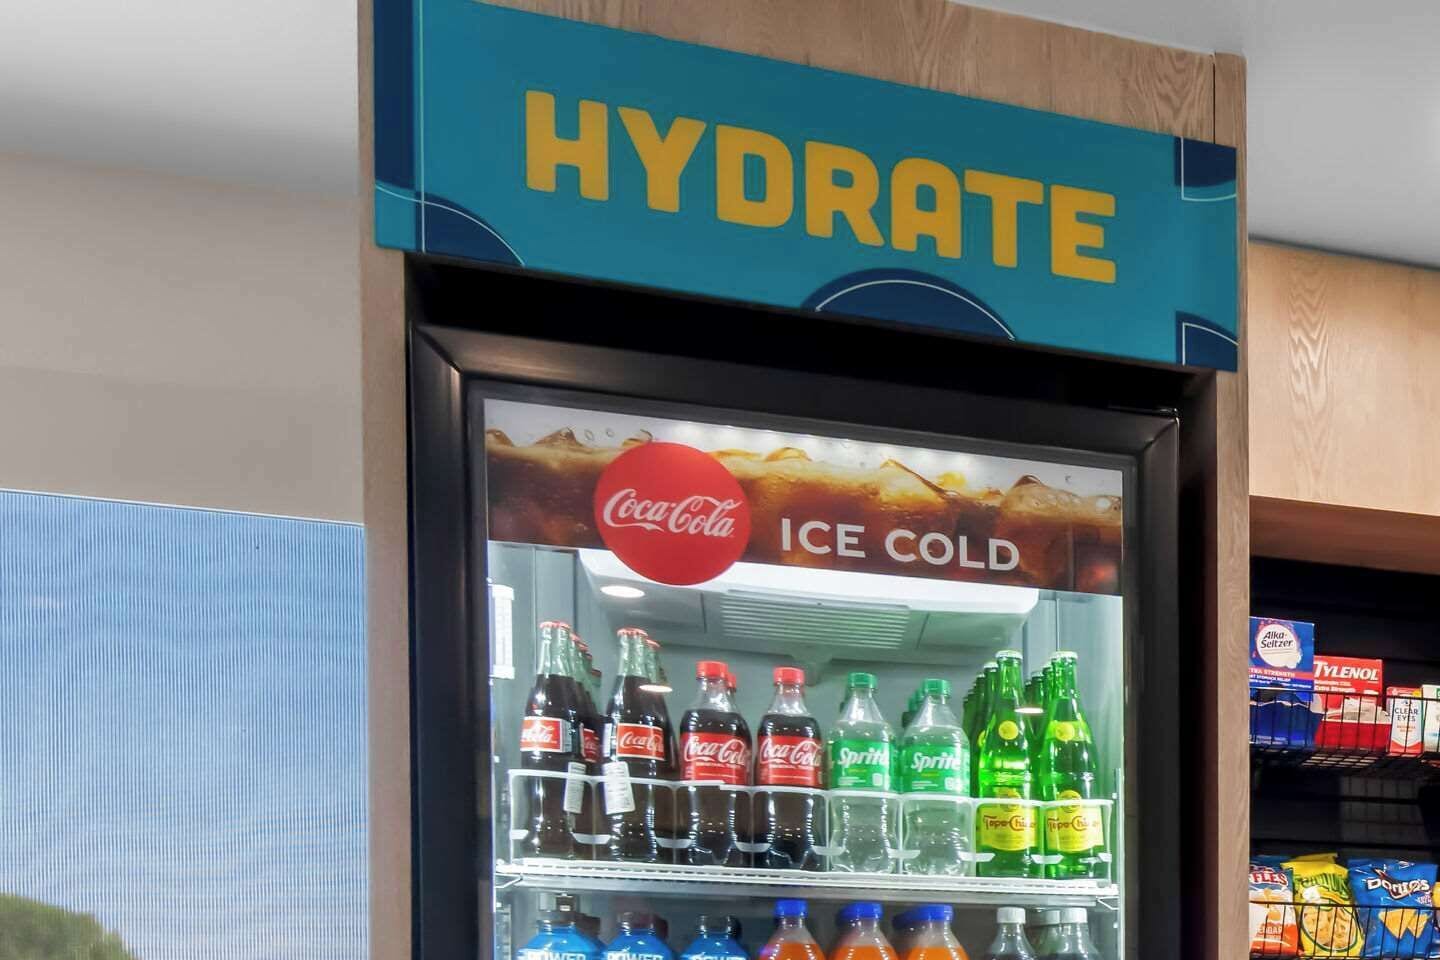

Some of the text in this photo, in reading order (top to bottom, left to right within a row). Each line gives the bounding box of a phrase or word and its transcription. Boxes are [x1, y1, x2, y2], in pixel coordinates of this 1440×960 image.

[525, 90, 1117, 284] HYDRATE
[603, 488, 741, 539] Coca-Cola
[781, 518, 1020, 571] ICE COLD
[1261, 639, 1294, 648] Seltzer
[1313, 661, 1379, 680] TYLENOL
[1394, 707, 1418, 715] CLEAR
